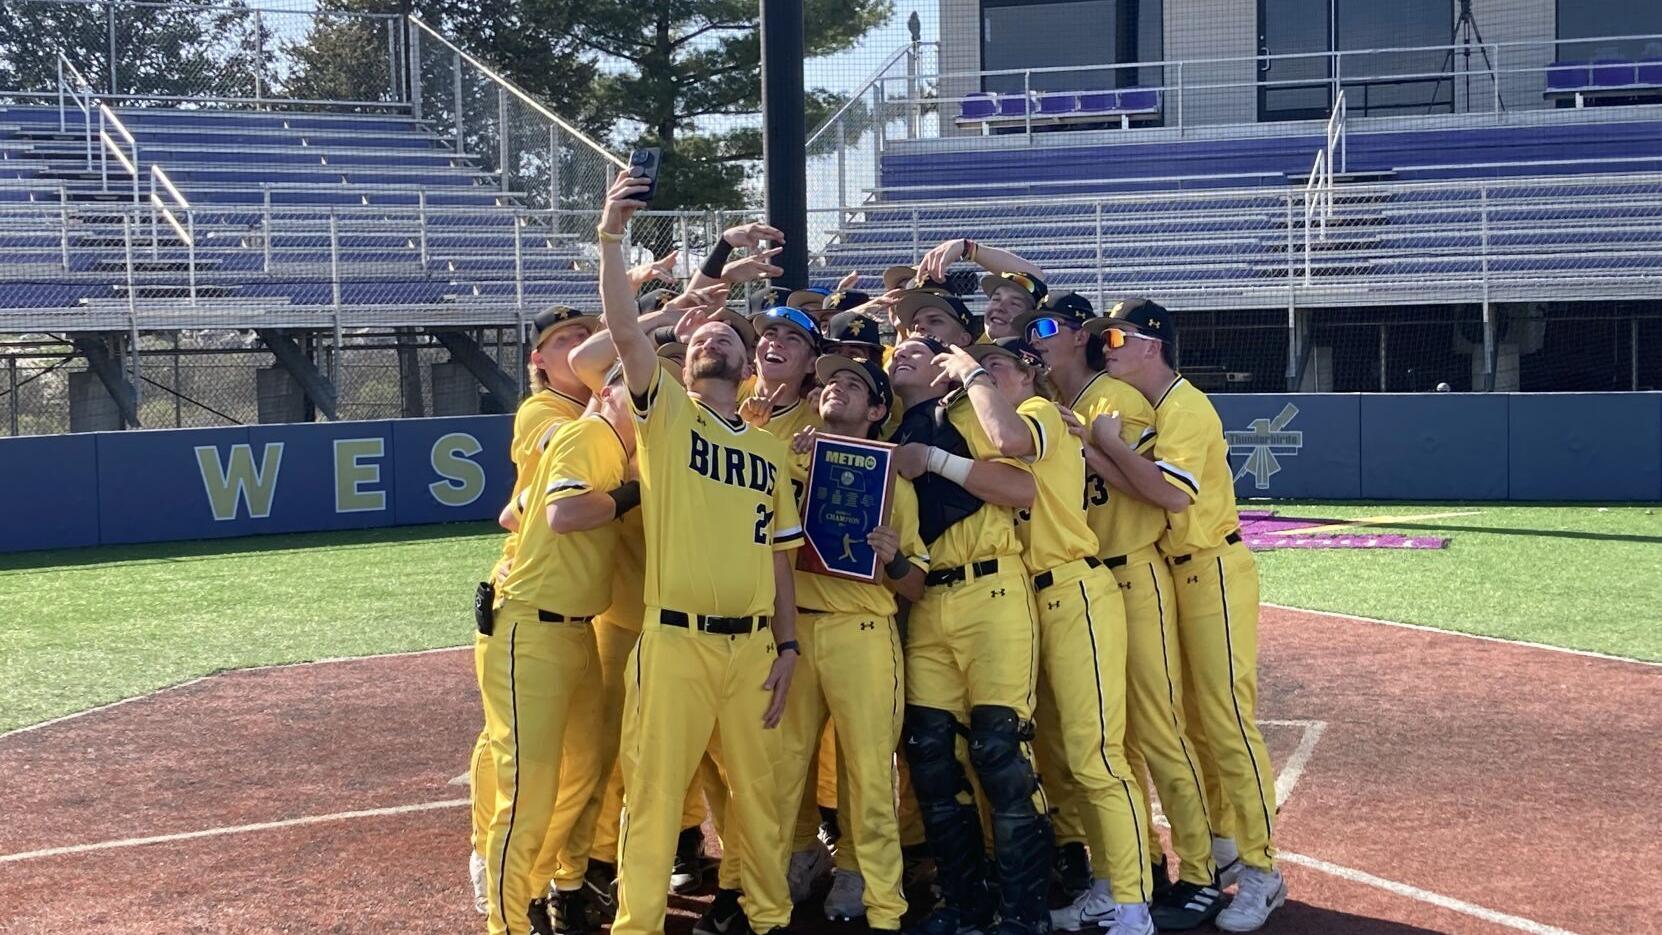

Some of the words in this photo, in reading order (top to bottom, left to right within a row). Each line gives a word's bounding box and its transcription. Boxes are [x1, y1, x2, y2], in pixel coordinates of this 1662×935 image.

[689, 429, 777, 496] BIRDS
[825, 450, 877, 471] METRO
[754, 503, 774, 545] 2
